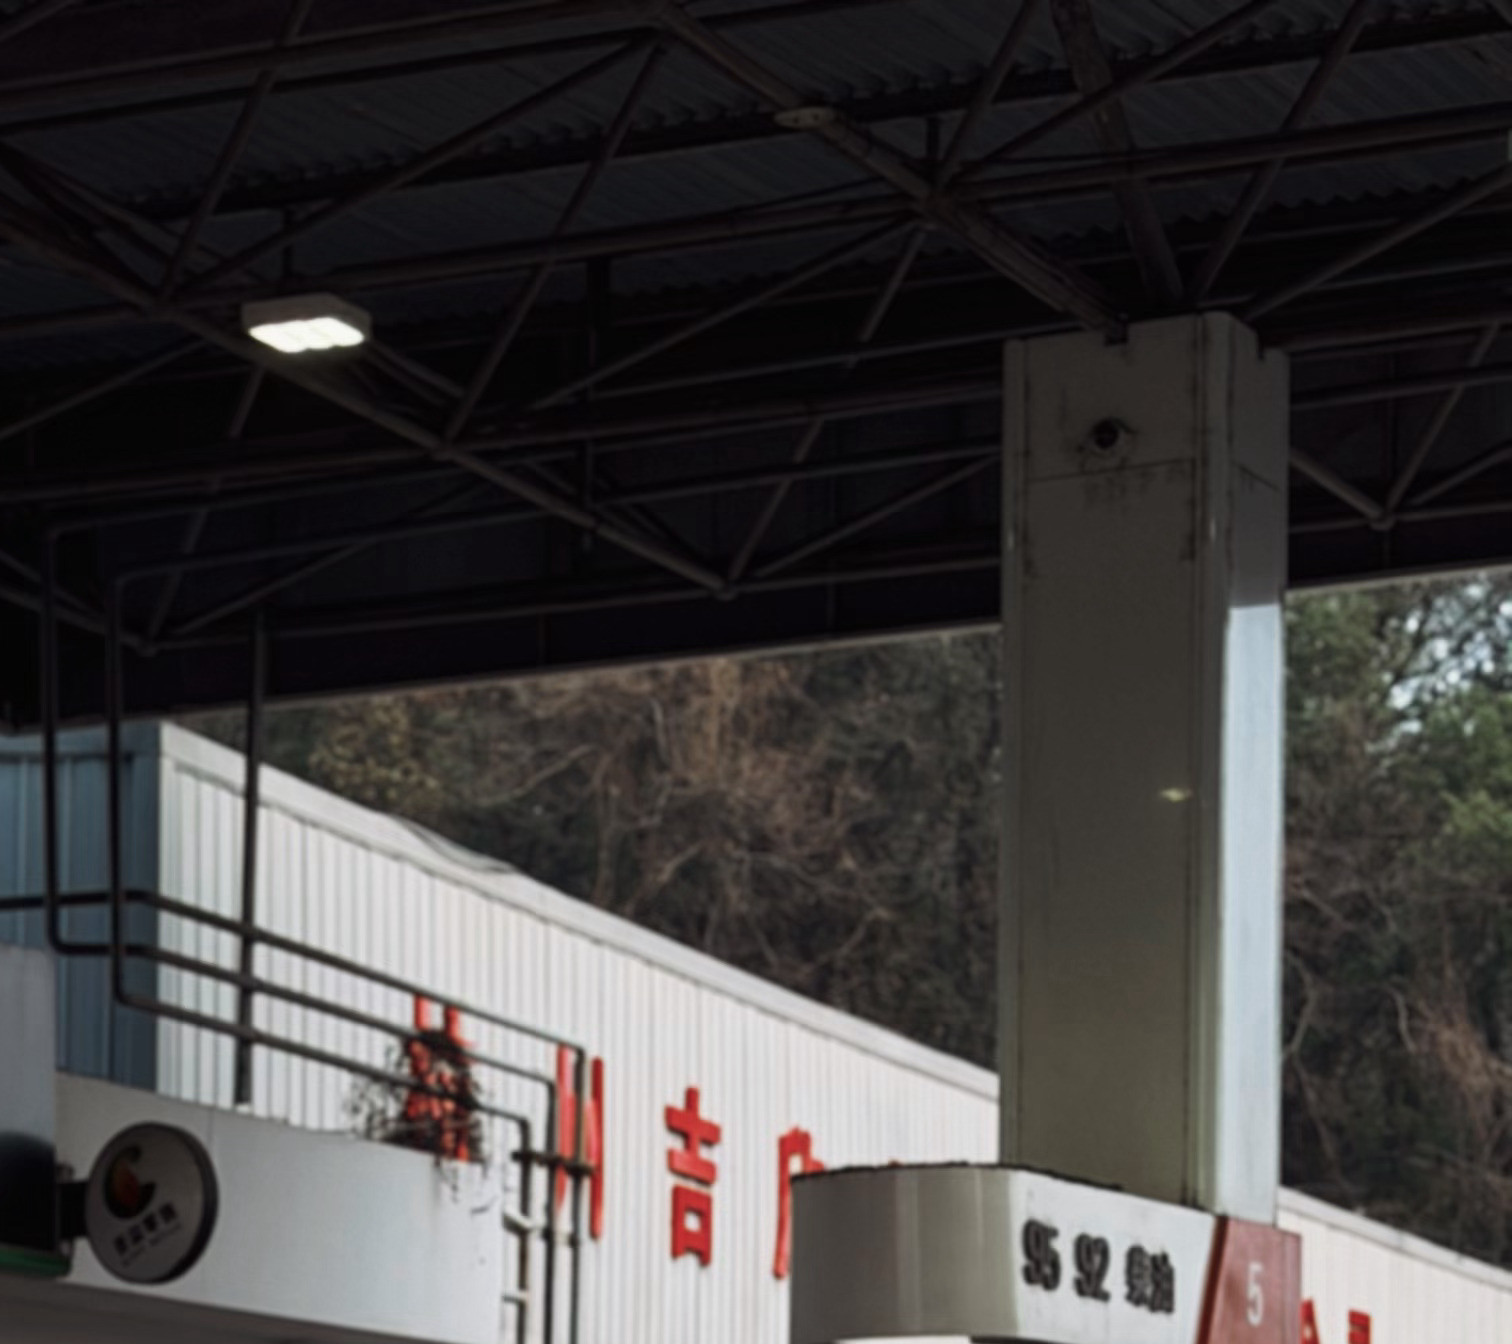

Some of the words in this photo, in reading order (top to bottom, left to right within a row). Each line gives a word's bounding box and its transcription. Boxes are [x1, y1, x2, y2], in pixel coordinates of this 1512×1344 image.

[1022, 1218, 1062, 1292] 95
[1073, 1232, 1110, 1303] 92
[1246, 1260, 1264, 1327] 5
